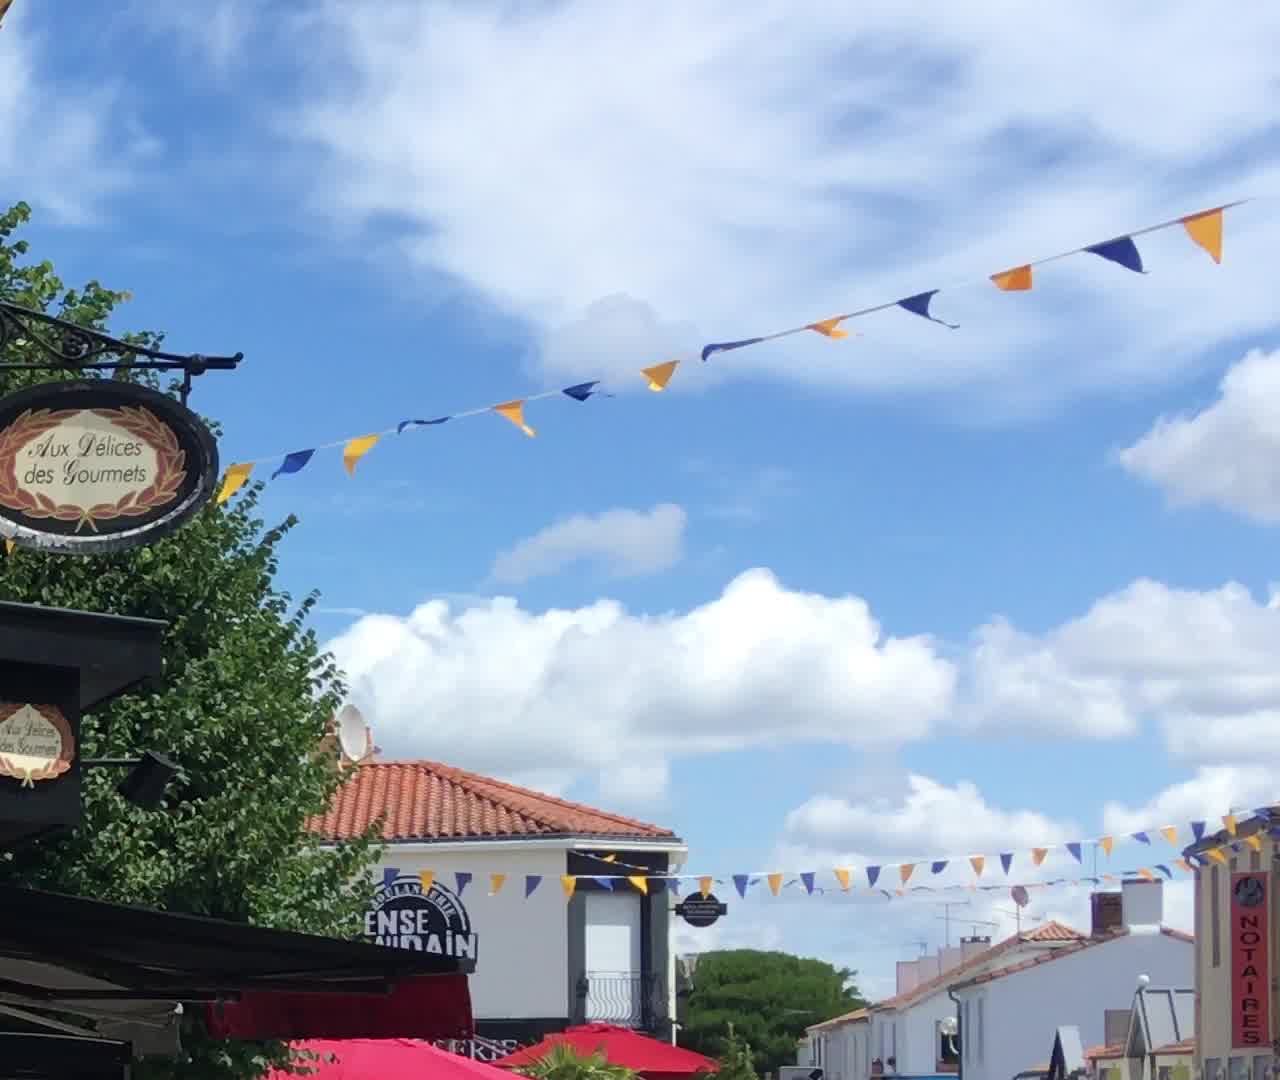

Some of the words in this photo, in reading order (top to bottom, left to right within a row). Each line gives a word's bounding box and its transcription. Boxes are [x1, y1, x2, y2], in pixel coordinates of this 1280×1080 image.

[27, 432, 70, 457] Aux
[78, 432, 144, 457] Délices
[24, 463, 55, 485] des
[63, 459, 147, 486] Gourmets
[363, 908, 430, 936] ENSE
[1239, 914, 1261, 1045] NOTAIRES
